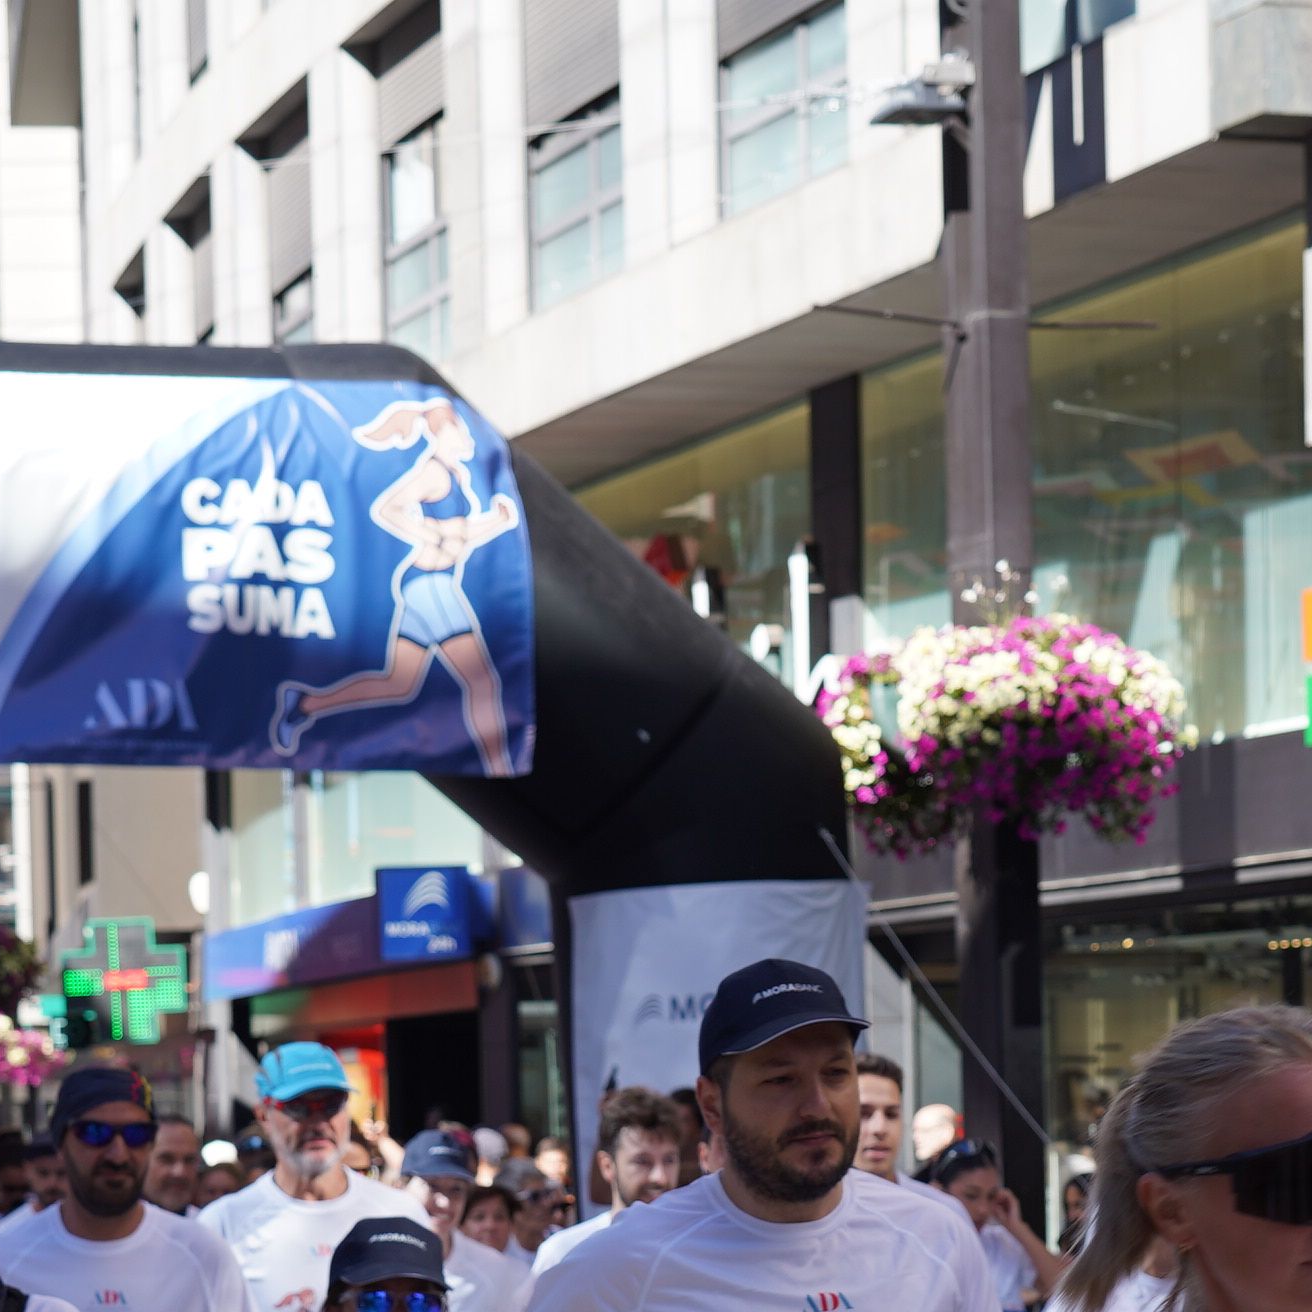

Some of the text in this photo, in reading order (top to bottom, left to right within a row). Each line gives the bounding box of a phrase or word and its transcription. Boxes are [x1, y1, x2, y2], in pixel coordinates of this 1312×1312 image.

[181, 476, 335, 527] CADA
[182, 525, 337, 585] PAS
[188, 583, 336, 640] SUMA
